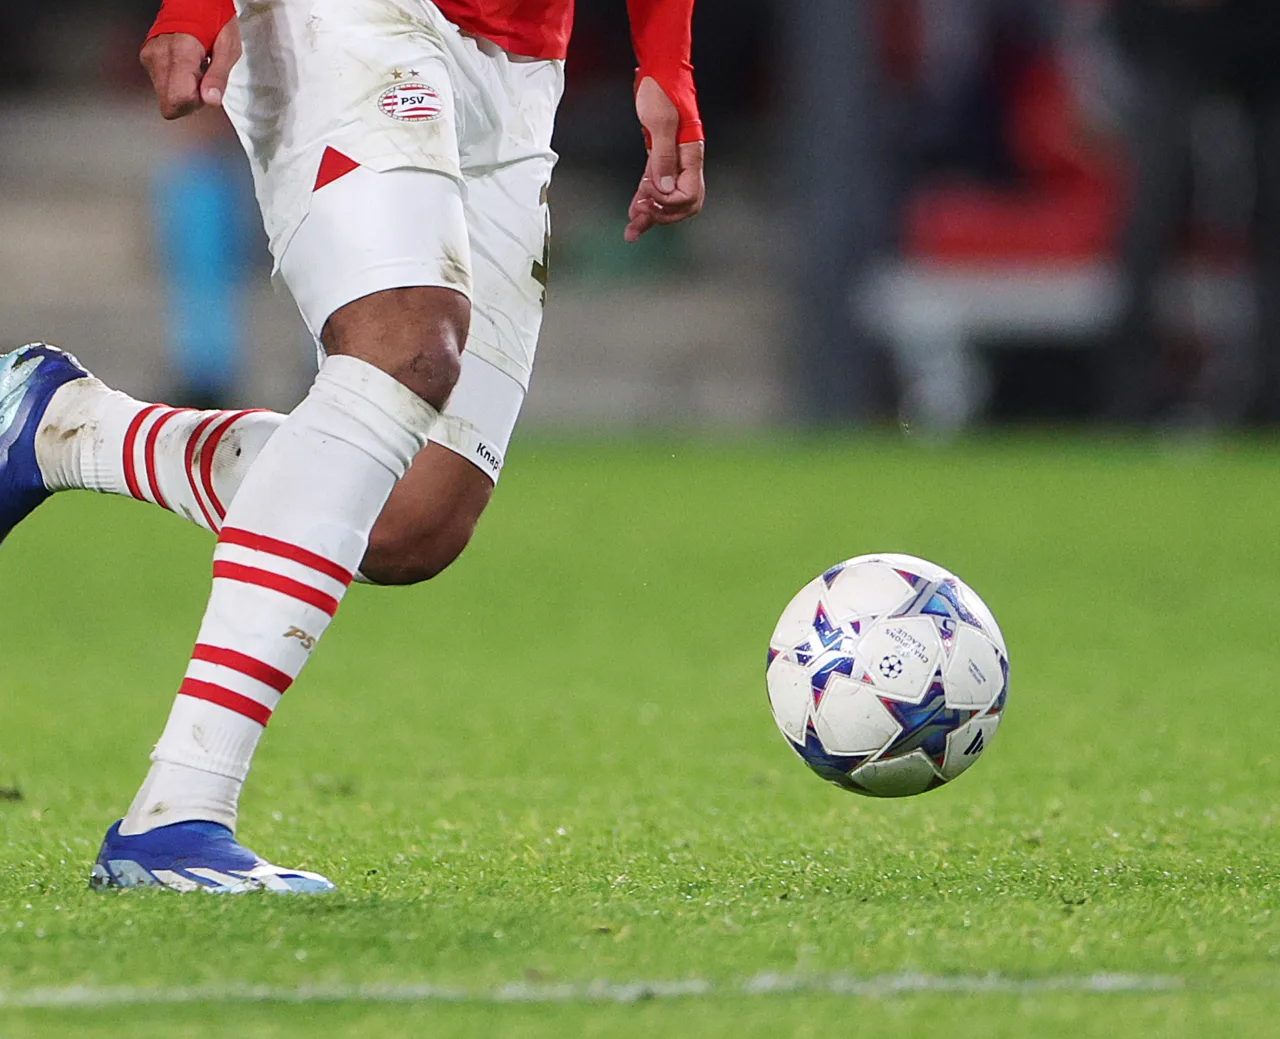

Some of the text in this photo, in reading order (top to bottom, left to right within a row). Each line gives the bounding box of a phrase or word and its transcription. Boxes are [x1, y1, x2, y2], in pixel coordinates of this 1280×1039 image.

[400, 95, 425, 106] PSV
[475, 442, 501, 472] Knap
[282, 625, 316, 651] PS
[884, 627, 929, 664] CHAPIONS
